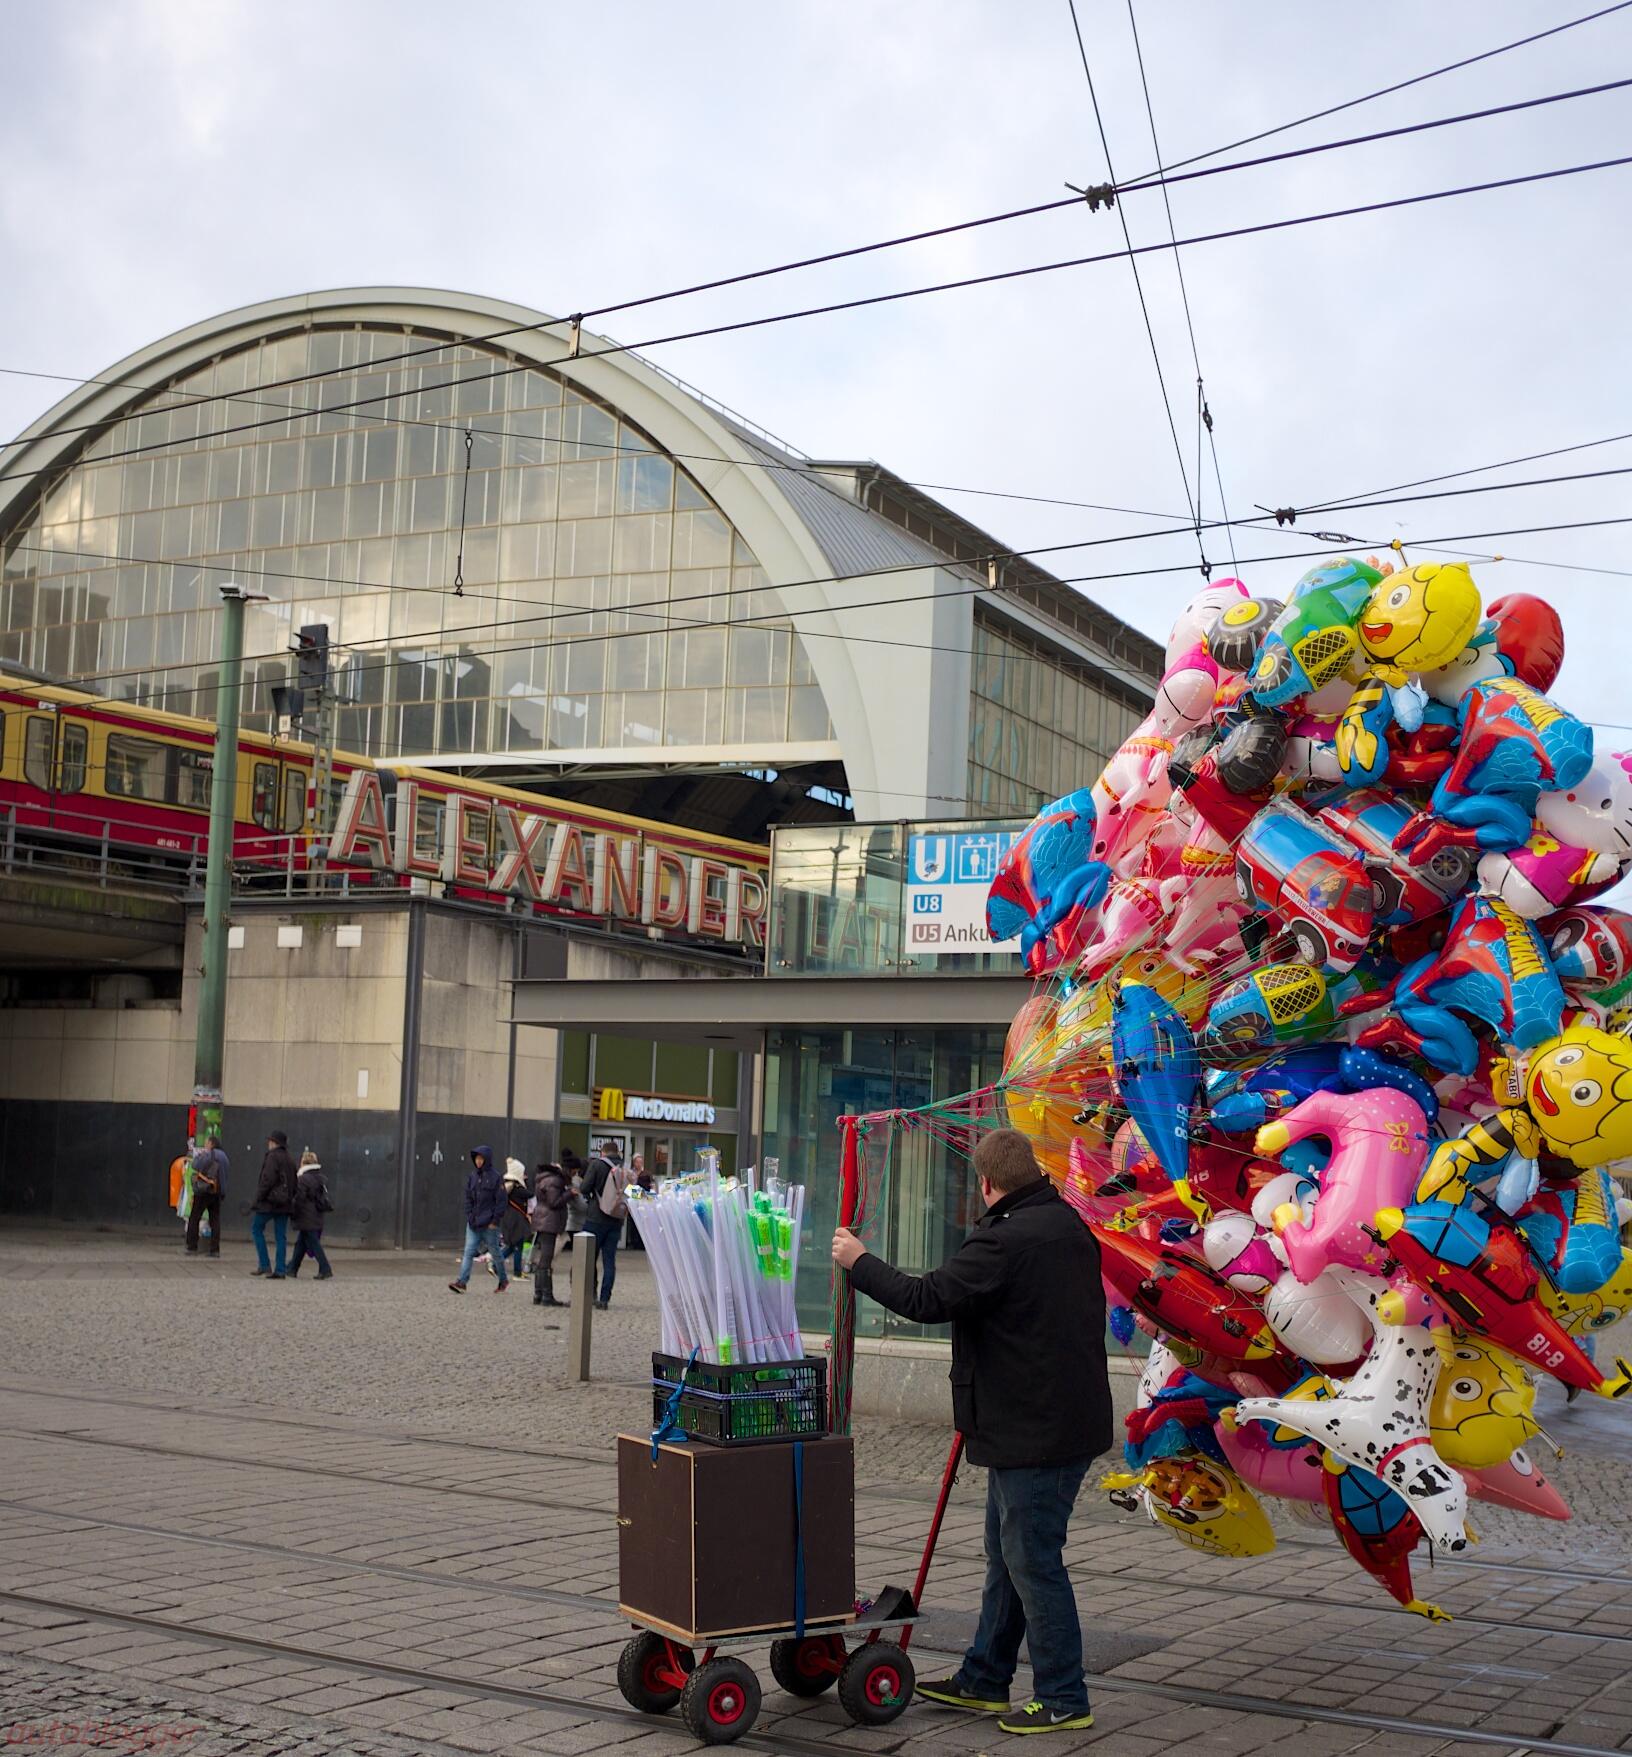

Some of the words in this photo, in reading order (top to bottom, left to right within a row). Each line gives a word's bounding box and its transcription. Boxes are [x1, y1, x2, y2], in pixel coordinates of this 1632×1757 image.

[915, 838, 947, 882] U
[916, 895, 940, 912] U8
[915, 924, 939, 941] U5
[626, 1097, 715, 1124] McDonald's
